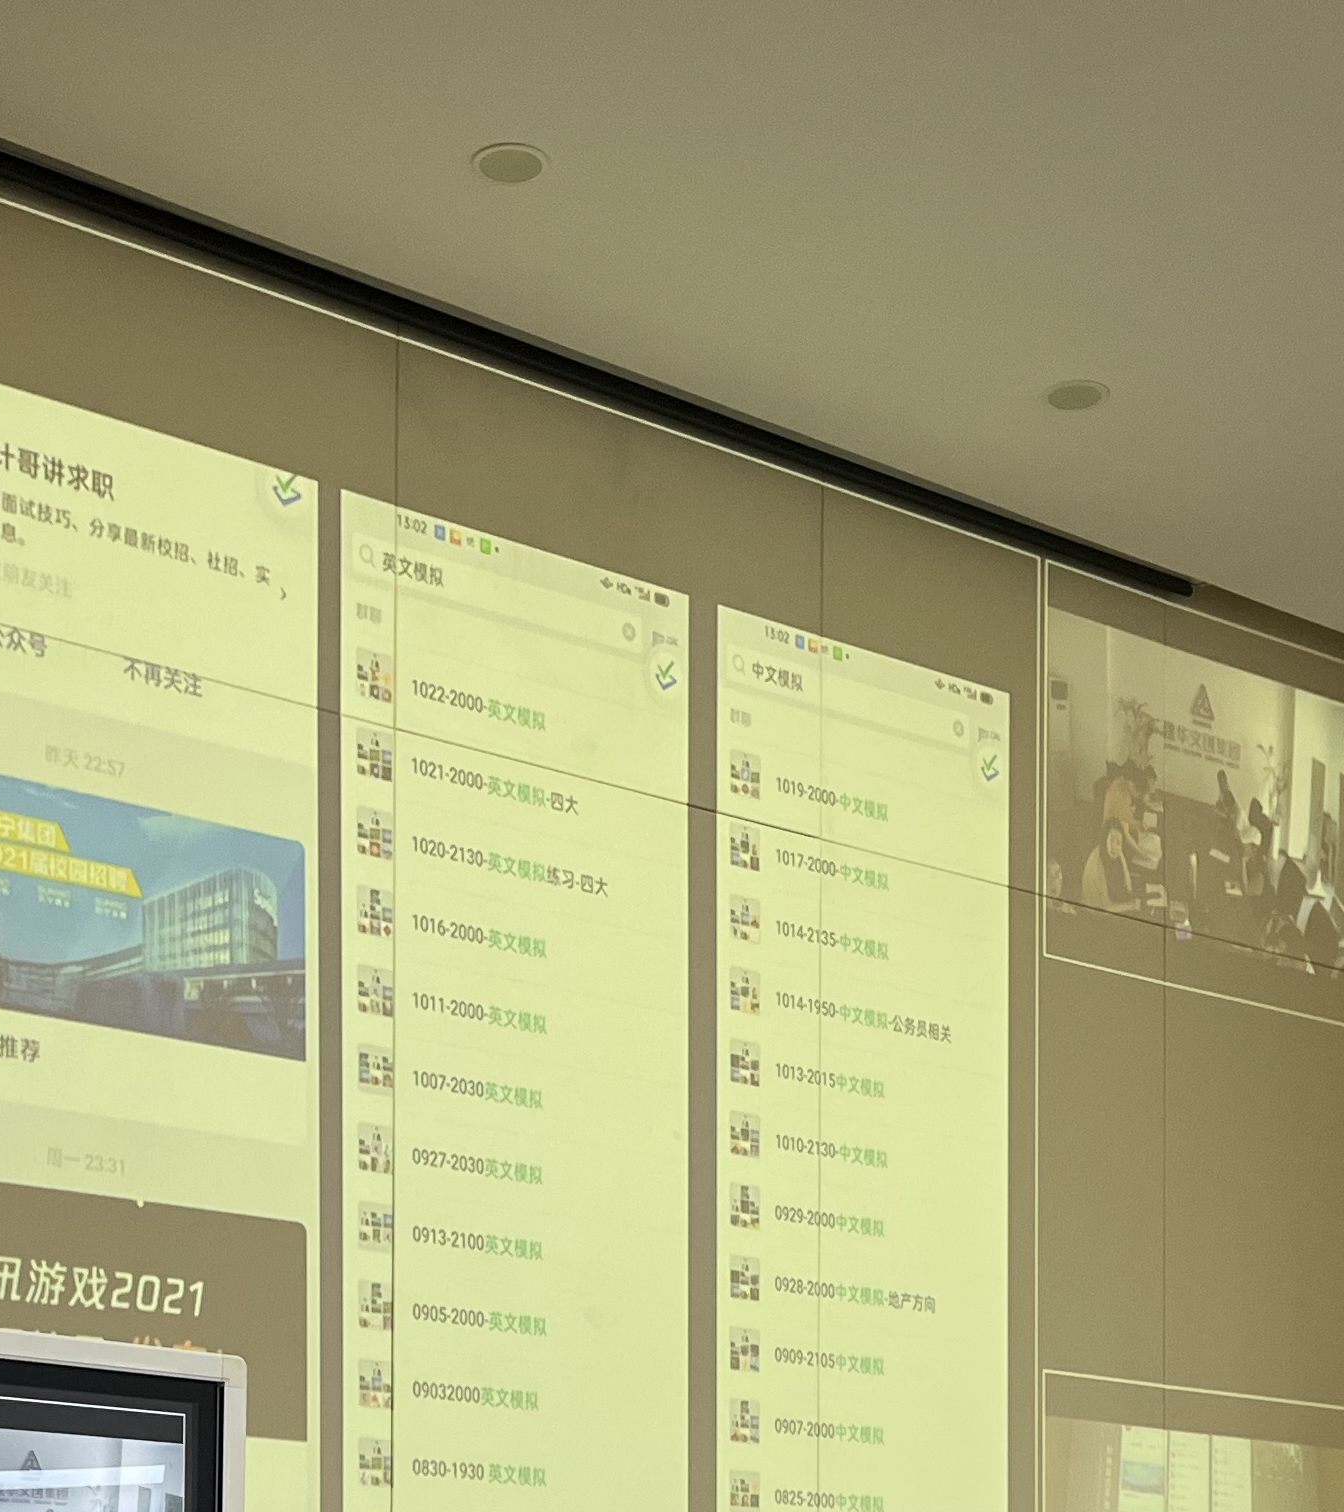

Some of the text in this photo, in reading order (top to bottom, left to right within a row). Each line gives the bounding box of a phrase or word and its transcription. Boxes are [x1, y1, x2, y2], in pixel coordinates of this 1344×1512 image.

[383, 552, 444, 587] 英文模拟
[123, 656, 203, 698] 不再关注
[752, 661, 804, 693] 中文模拟
